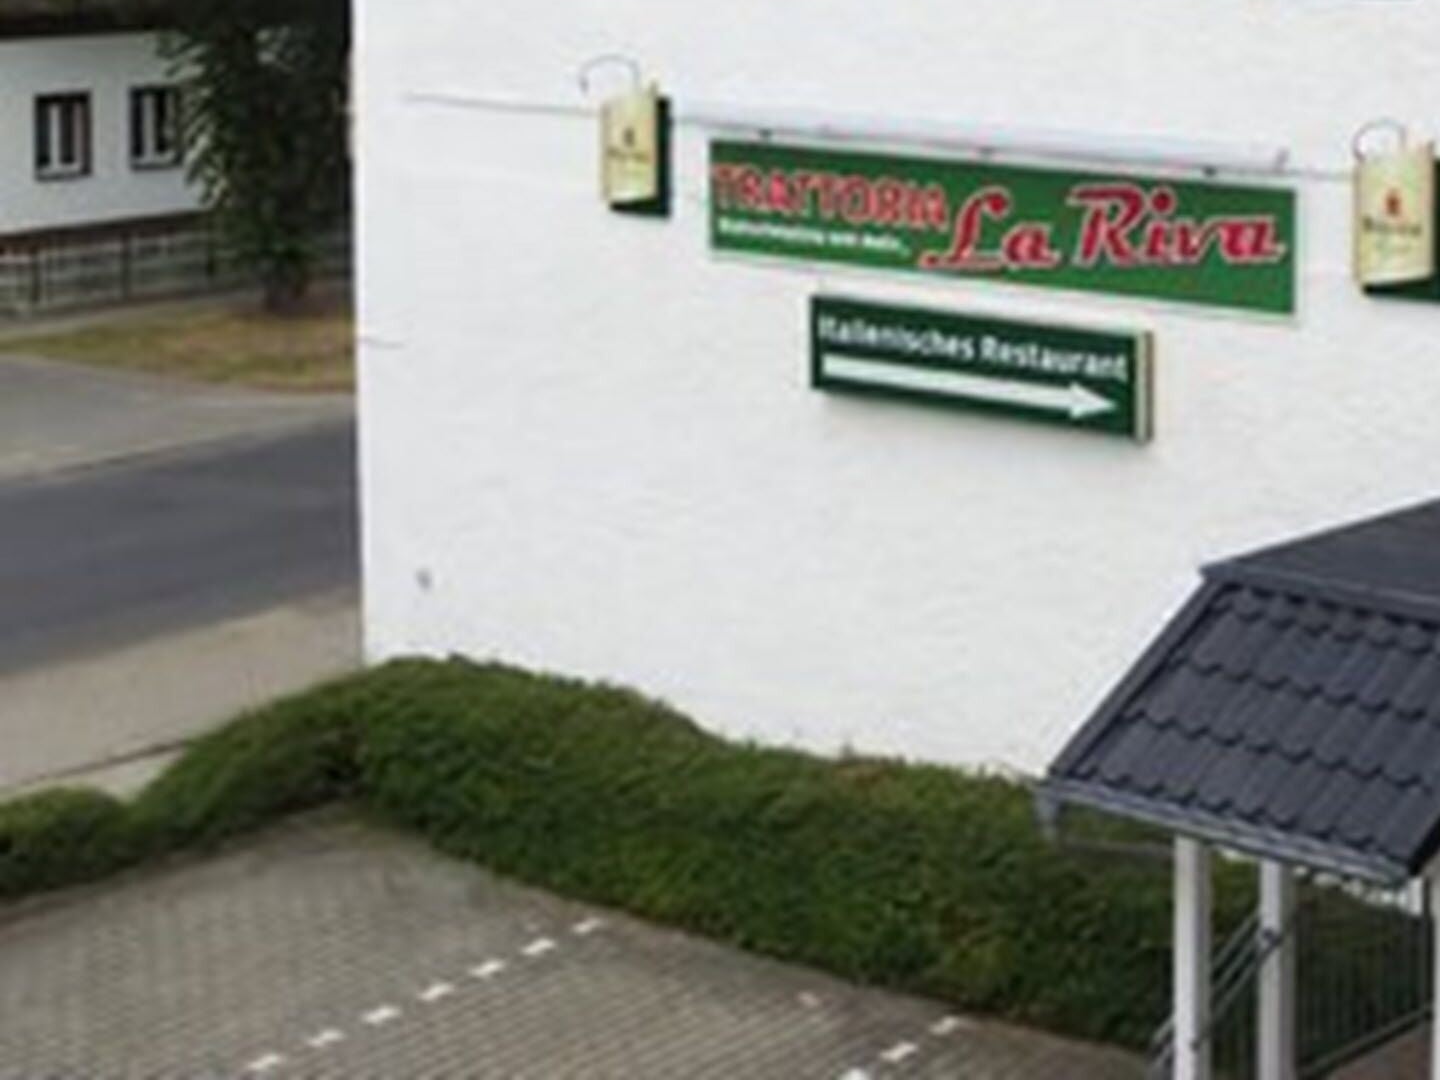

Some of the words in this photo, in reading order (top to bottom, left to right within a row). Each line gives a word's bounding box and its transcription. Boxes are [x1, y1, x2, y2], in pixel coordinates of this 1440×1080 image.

[712, 163, 949, 231] TRATTORIA
[919, 185, 1060, 271] La
[1066, 182, 1287, 267] Riva
[816, 313, 975, 361] Italienisches
[979, 334, 1130, 382] Restaurant
